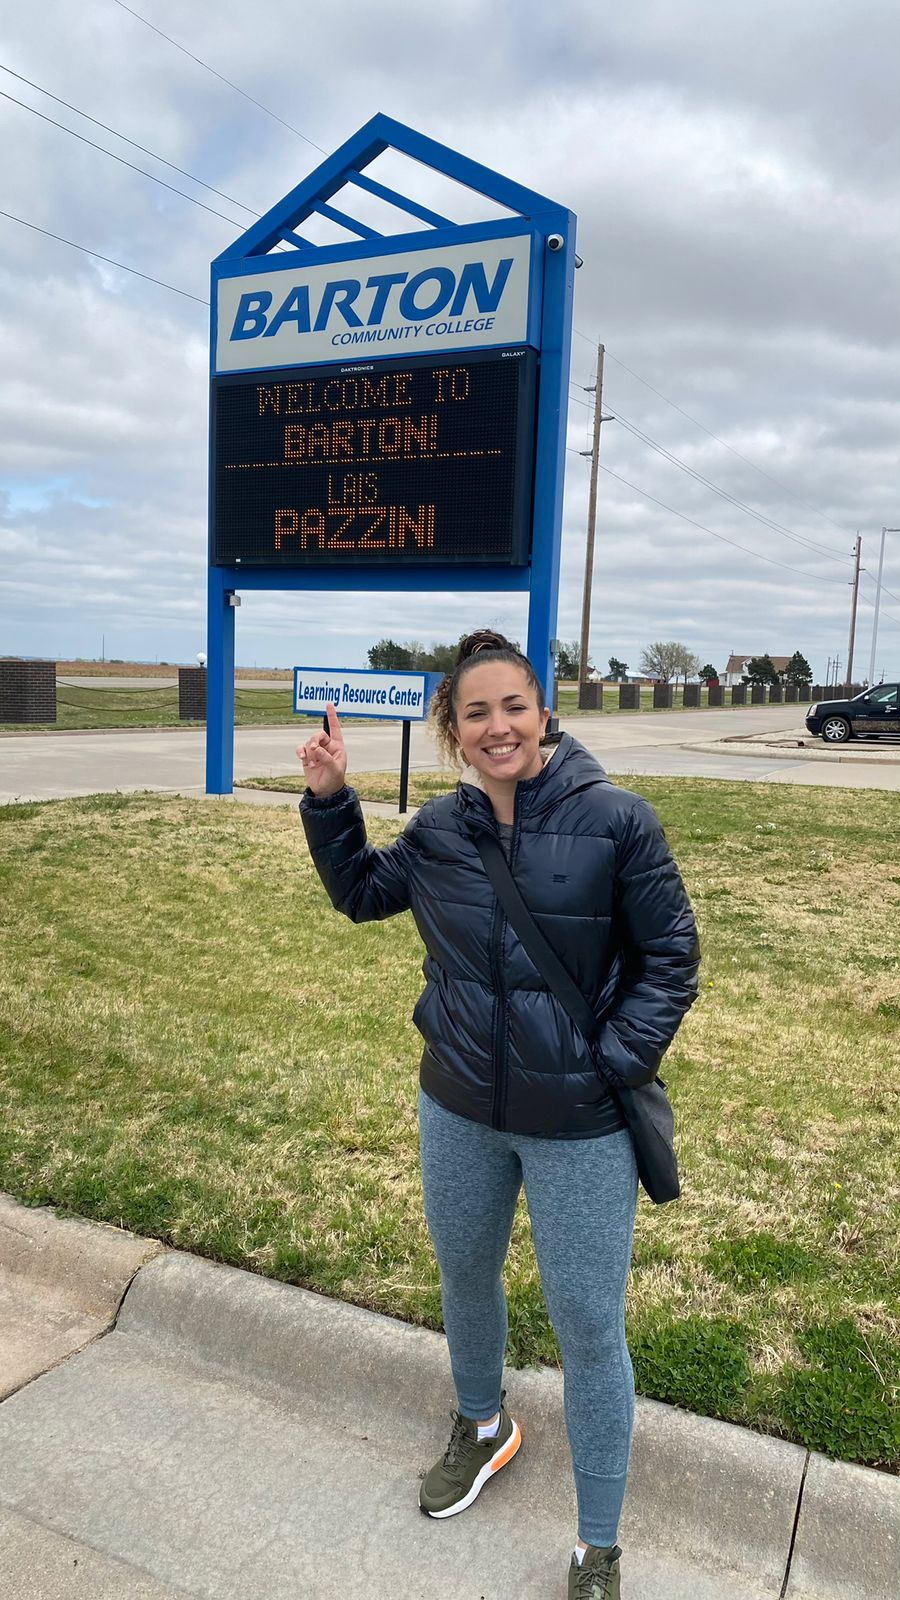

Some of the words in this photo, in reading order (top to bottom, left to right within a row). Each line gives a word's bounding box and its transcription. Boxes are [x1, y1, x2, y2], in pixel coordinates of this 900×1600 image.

[230, 258, 514, 342] BARTON
[331, 325, 423, 346] COMMUNITY
[425, 317, 496, 337] COLLEGE
[256, 373, 413, 416] WELCOME
[432, 368, 470, 402] TO
[283, 414, 438, 459] BARTON!
[327, 472, 379, 504] LAIS
[274, 504, 436, 550] PAZZINI
[299, 681, 340, 707] Learning
[342, 683, 387, 704] Resource
[388, 685, 422, 706] Center
